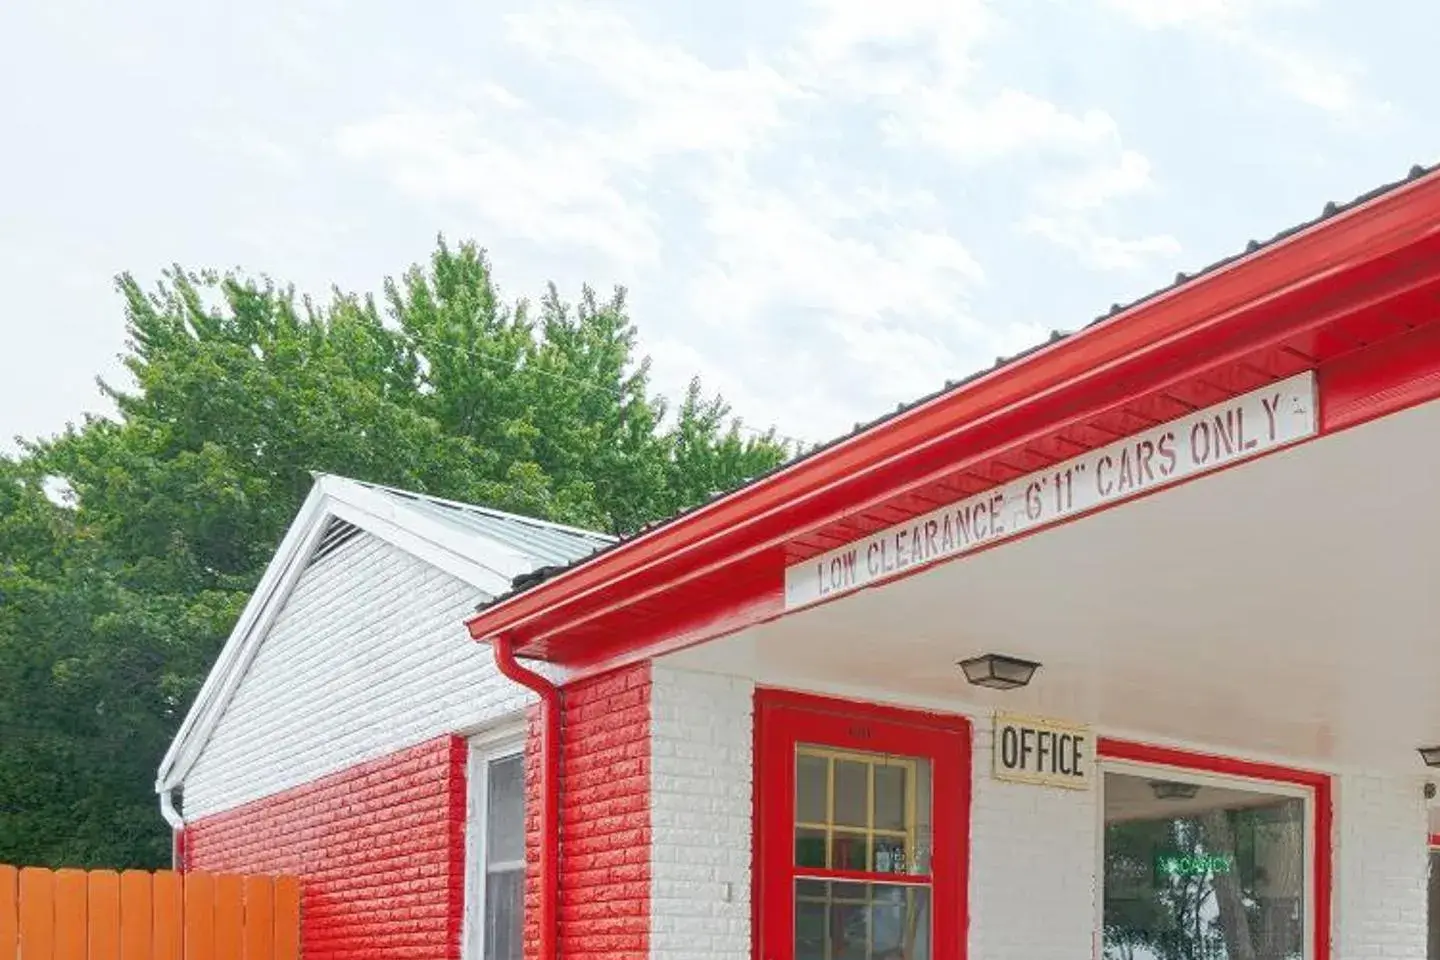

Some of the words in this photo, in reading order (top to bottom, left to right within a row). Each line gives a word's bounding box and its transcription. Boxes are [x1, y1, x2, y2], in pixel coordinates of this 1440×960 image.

[817, 549, 858, 596] LOW
[866, 494, 1004, 575] CLEARANCE
[1096, 431, 1176, 497] CARS
[1190, 392, 1281, 465] ONLY
[1001, 725, 1084, 777] OFFICE
